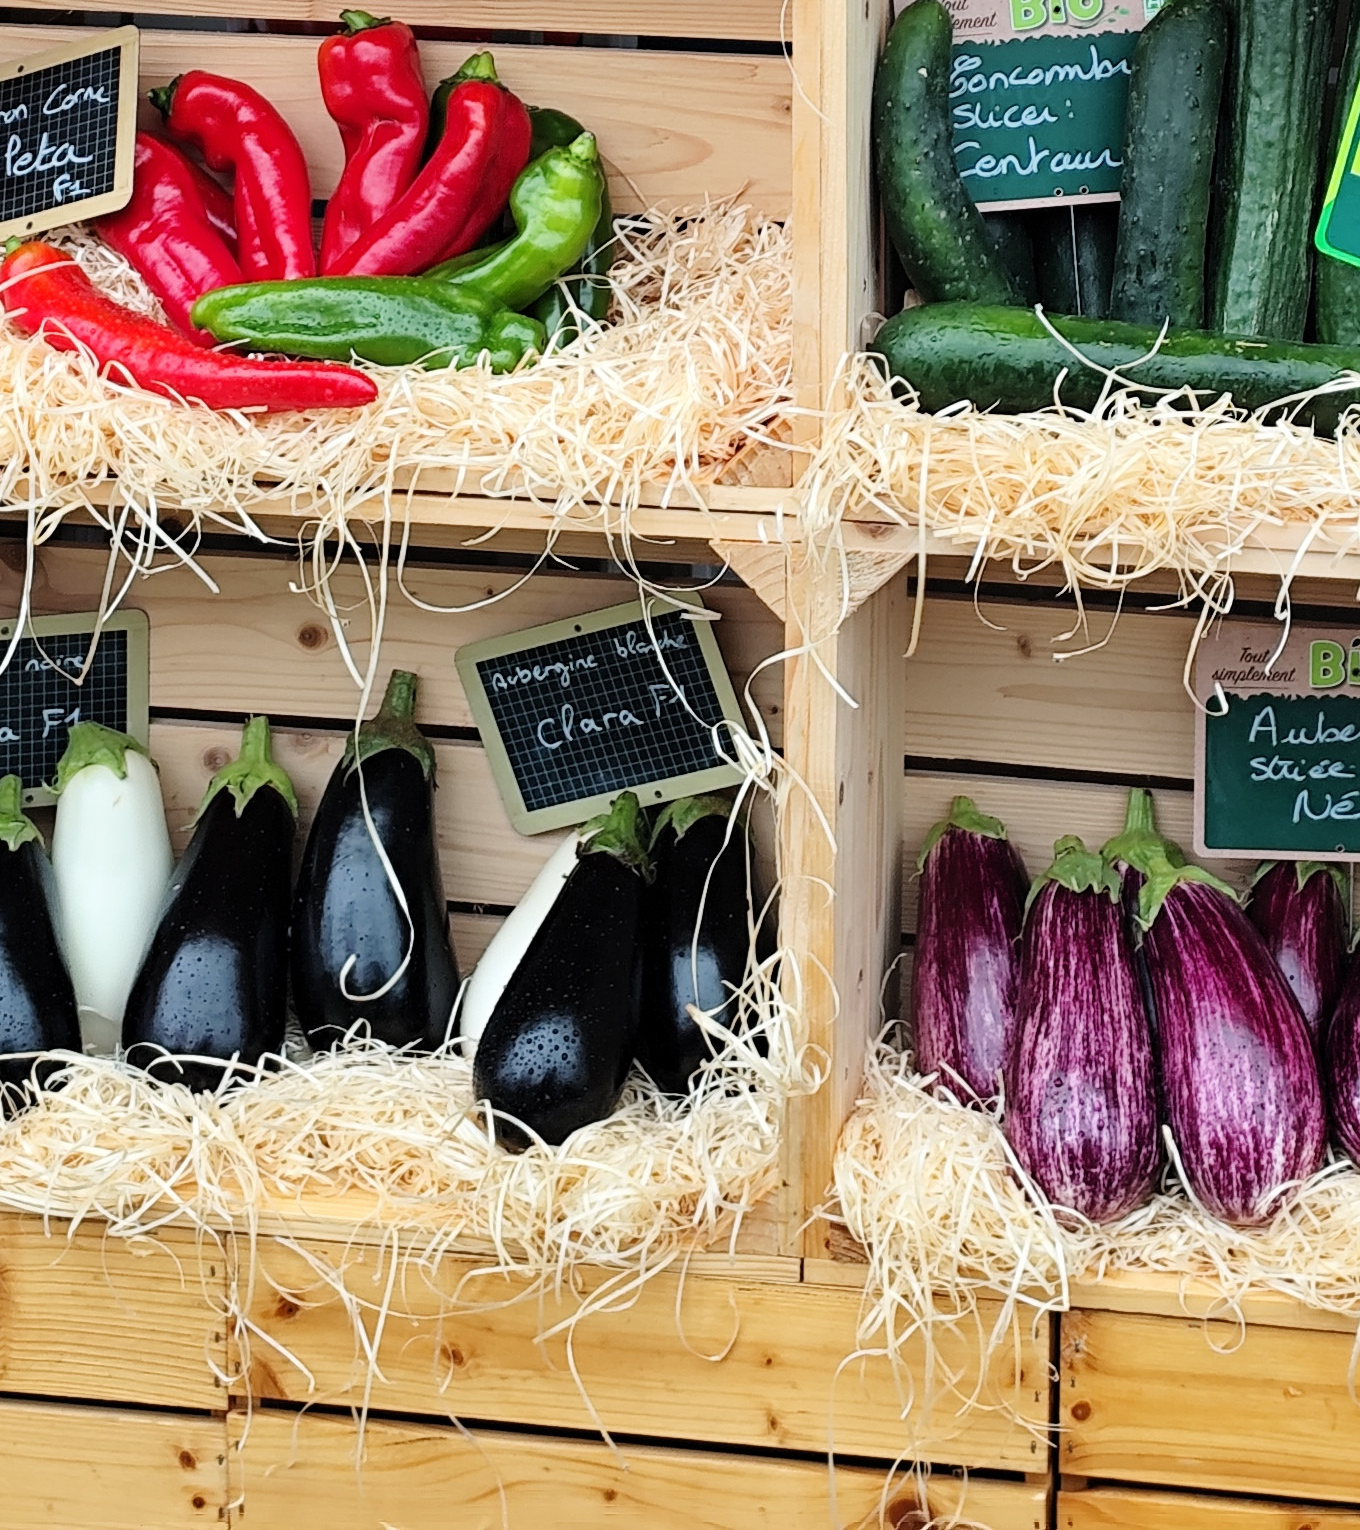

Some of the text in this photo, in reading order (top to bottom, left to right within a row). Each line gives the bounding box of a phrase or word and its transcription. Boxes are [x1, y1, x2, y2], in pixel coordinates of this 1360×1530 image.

[492, 653, 598, 688] Aubergine
[1240, 647, 1270, 663] Tout
[1211, 666, 1296, 685] simplement
[42, 706, 81, 739] F1
[537, 703, 644, 750] Clara
